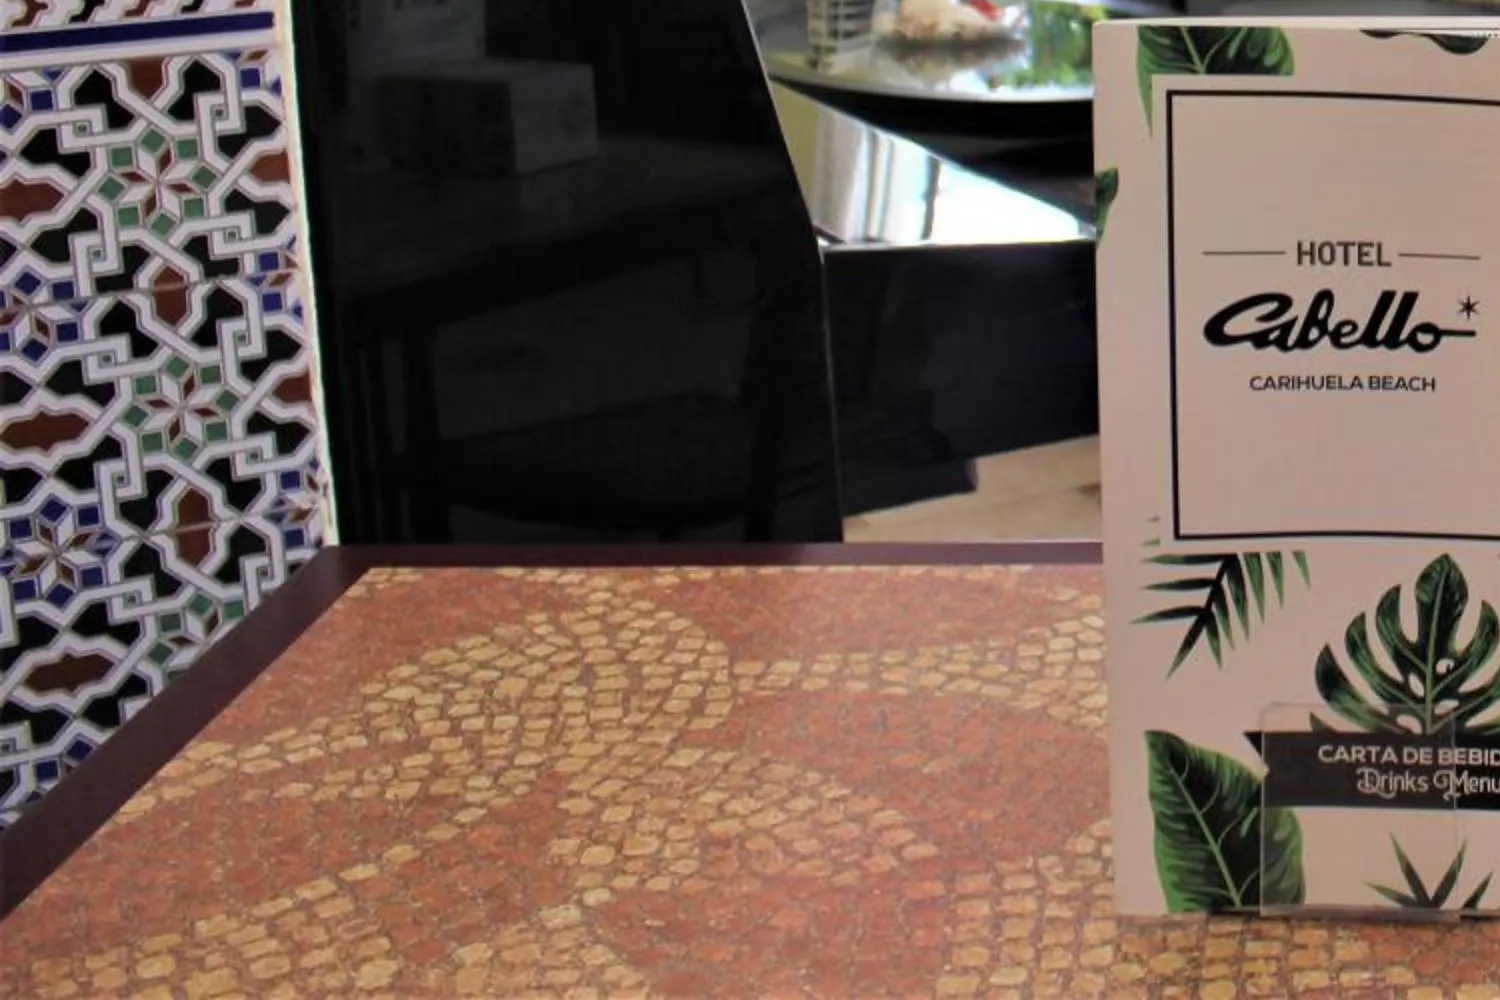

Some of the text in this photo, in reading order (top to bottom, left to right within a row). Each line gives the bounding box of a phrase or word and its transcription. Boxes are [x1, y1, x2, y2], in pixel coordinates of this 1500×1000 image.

[1296, 241, 1392, 267] HOTEL
[1203, 289, 1476, 354] Cabello
[1249, 375, 1436, 392] CARIHUELA BEACH
[1318, 745, 1398, 764] CARTA
[1402, 746, 1433, 765] DE
[1356, 767, 1429, 799] Drinks
